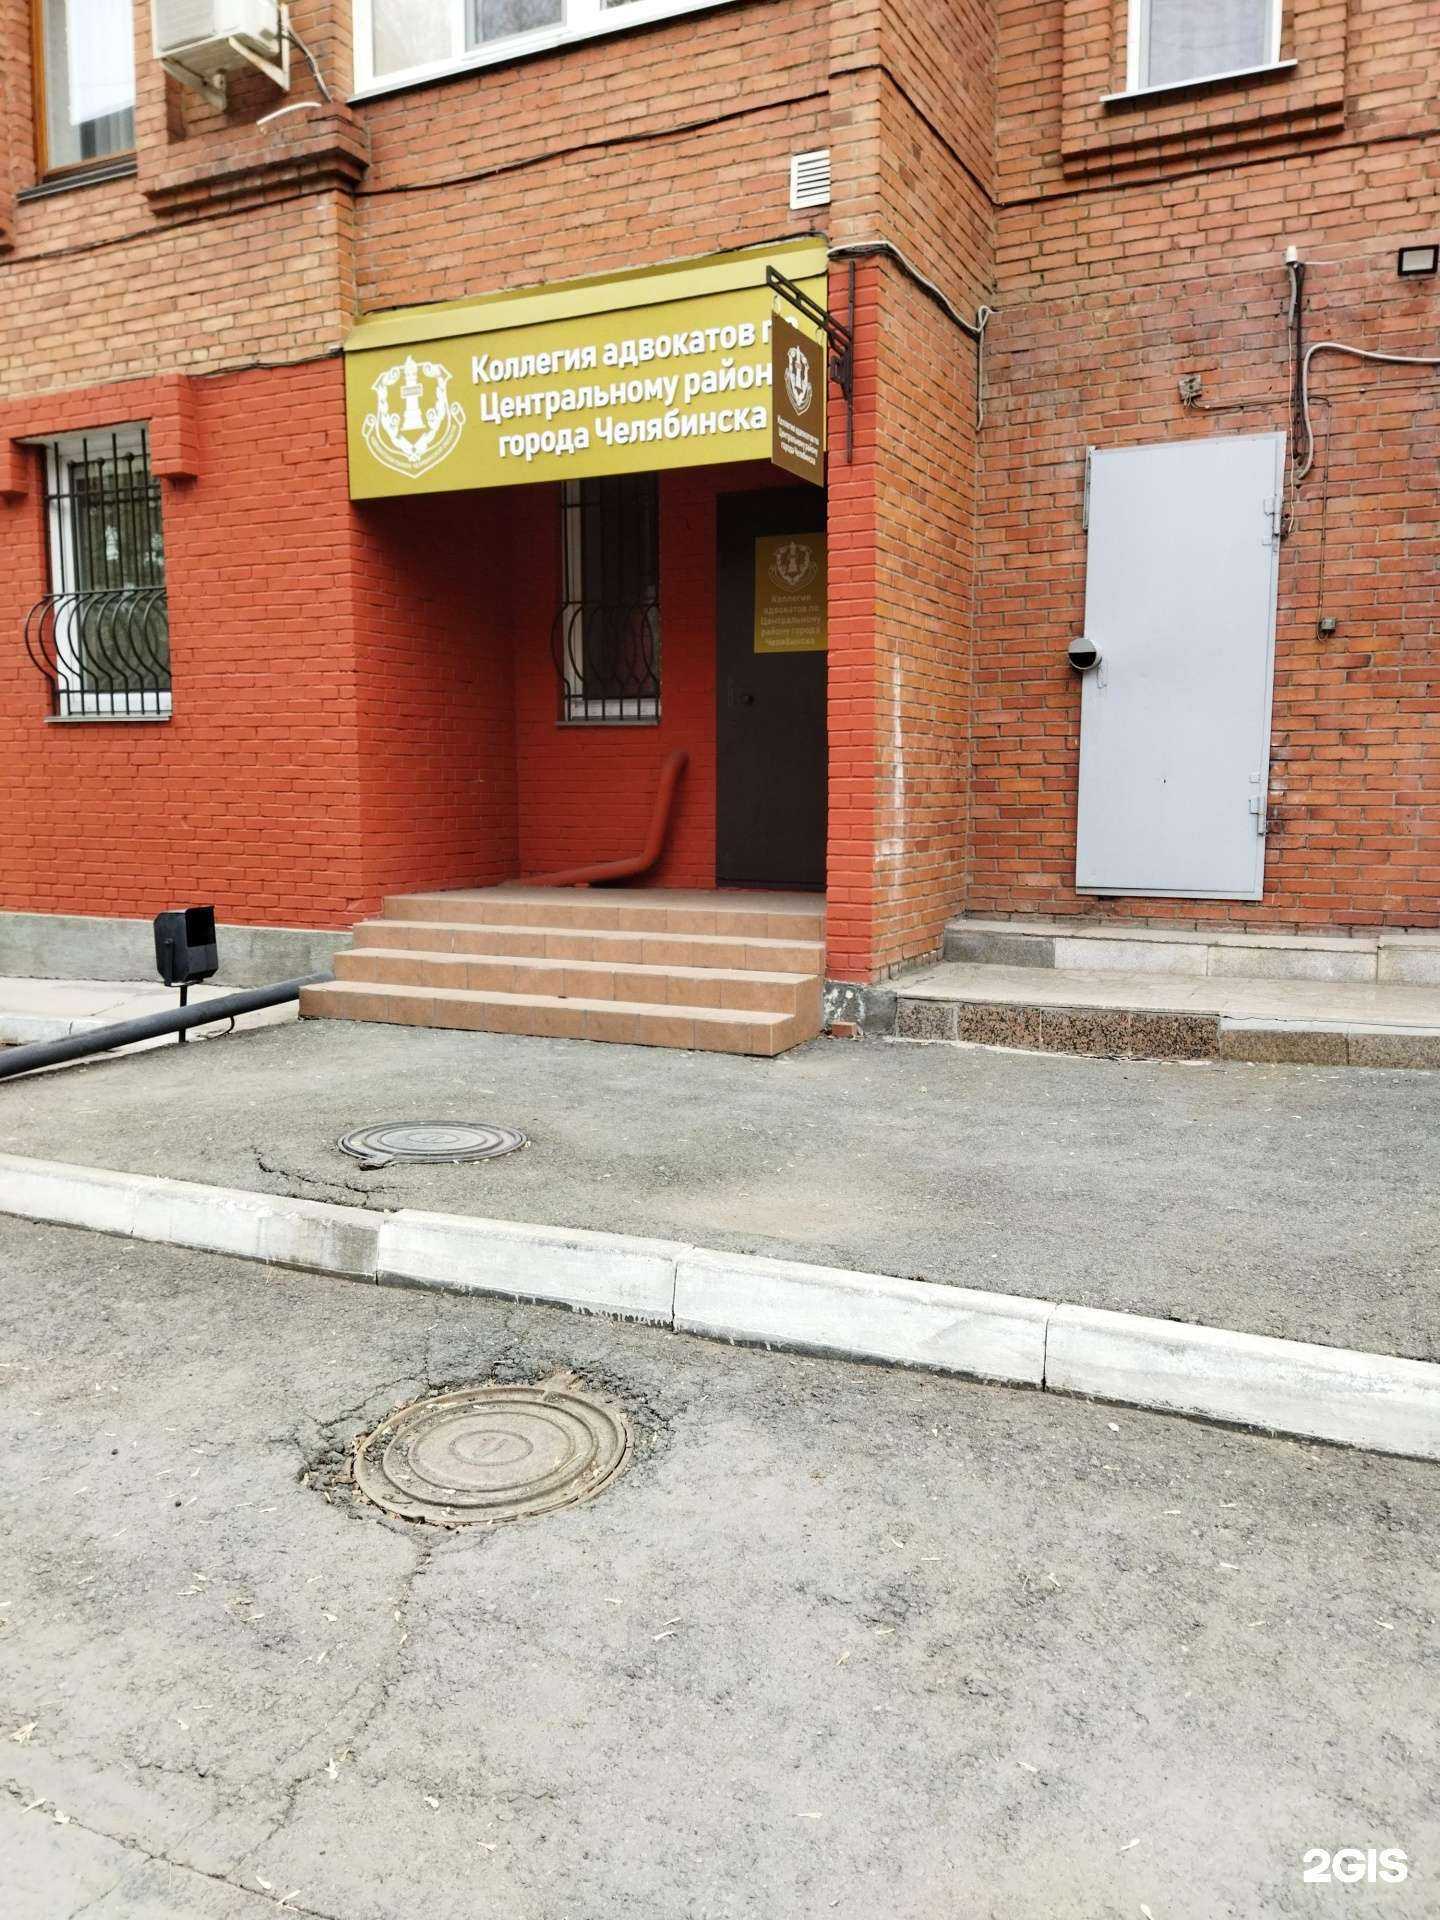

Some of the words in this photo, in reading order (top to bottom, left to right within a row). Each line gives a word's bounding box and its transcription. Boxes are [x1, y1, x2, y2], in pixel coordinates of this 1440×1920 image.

[471, 345, 597, 385] Коллегия
[602, 322, 756, 369] адвокатов
[480, 374, 679, 425] Центральному
[684, 357, 773, 404] район
[499, 426, 590, 462] города
[595, 405, 768, 446] Челябинска
